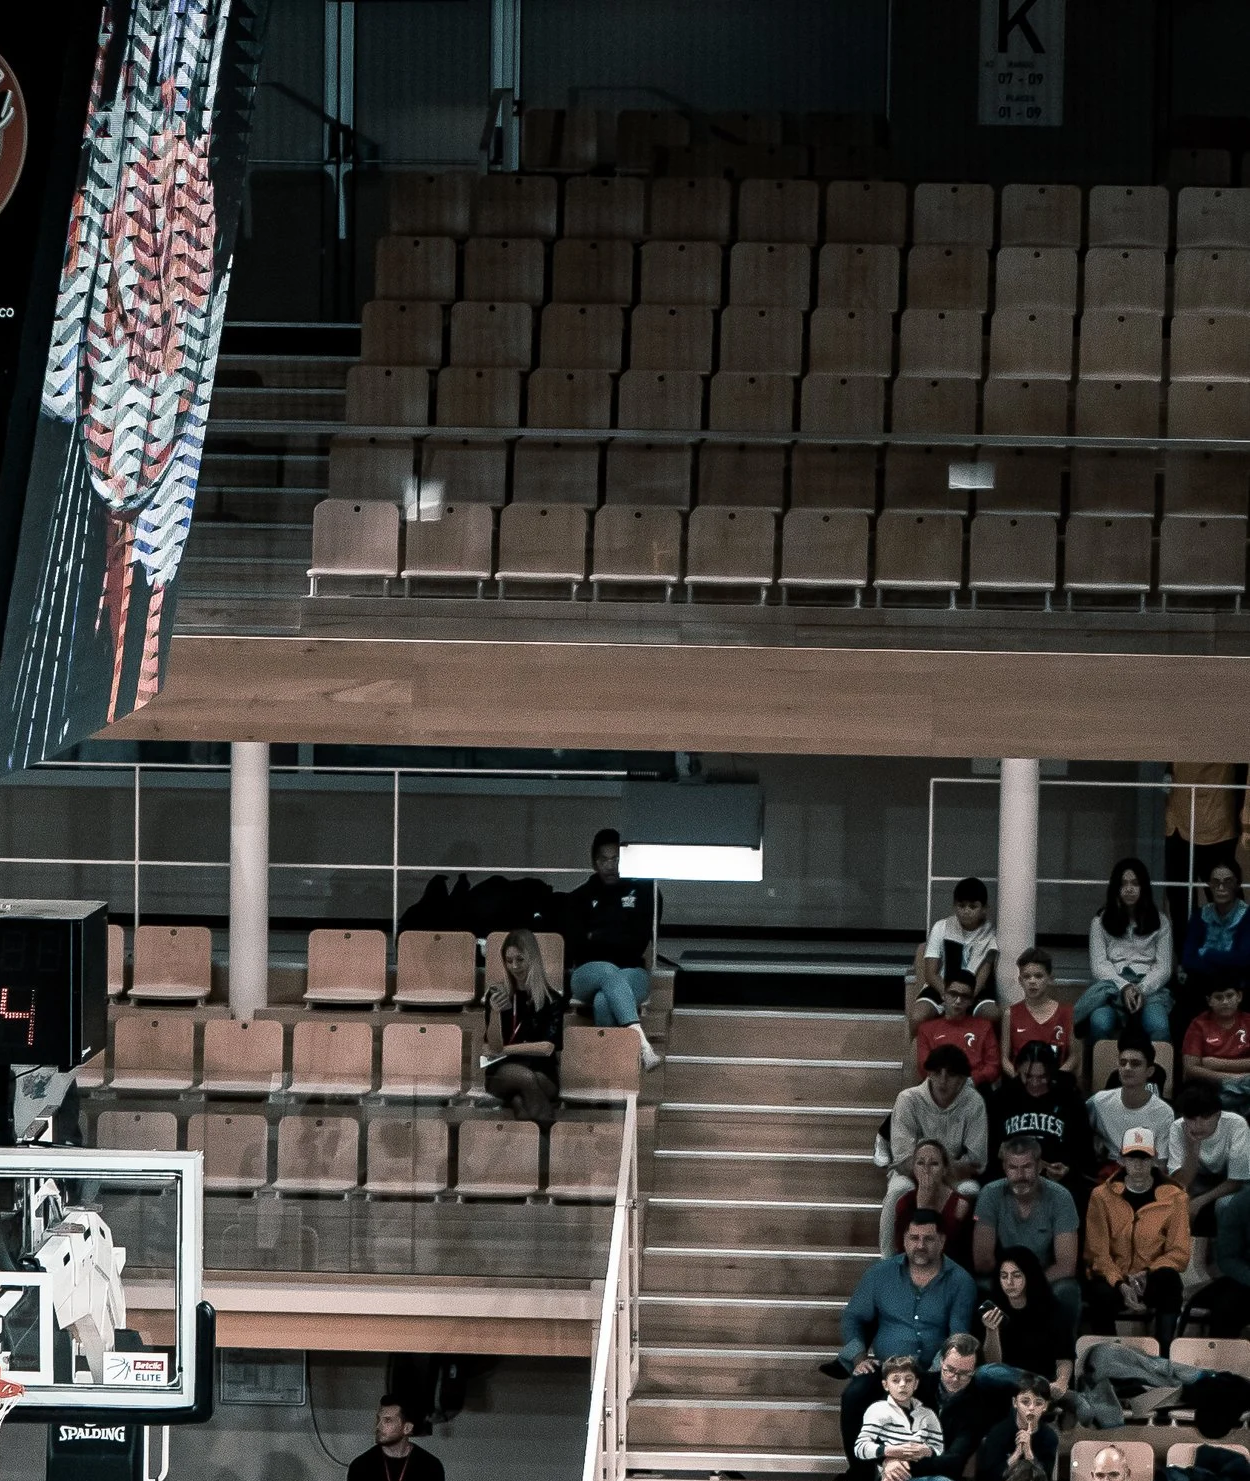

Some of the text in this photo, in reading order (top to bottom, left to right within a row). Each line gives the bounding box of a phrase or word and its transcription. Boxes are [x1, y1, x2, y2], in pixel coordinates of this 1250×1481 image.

[998, 0, 1046, 53] K
[997, 73, 1013, 84] 07
[1028, 73, 1043, 85] 09
[998, 106, 1012, 118] 01
[1026, 106, 1042, 119] 09
[0, 987, 36, 1046] 4
[59, 1425, 126, 1442] SPALDING
